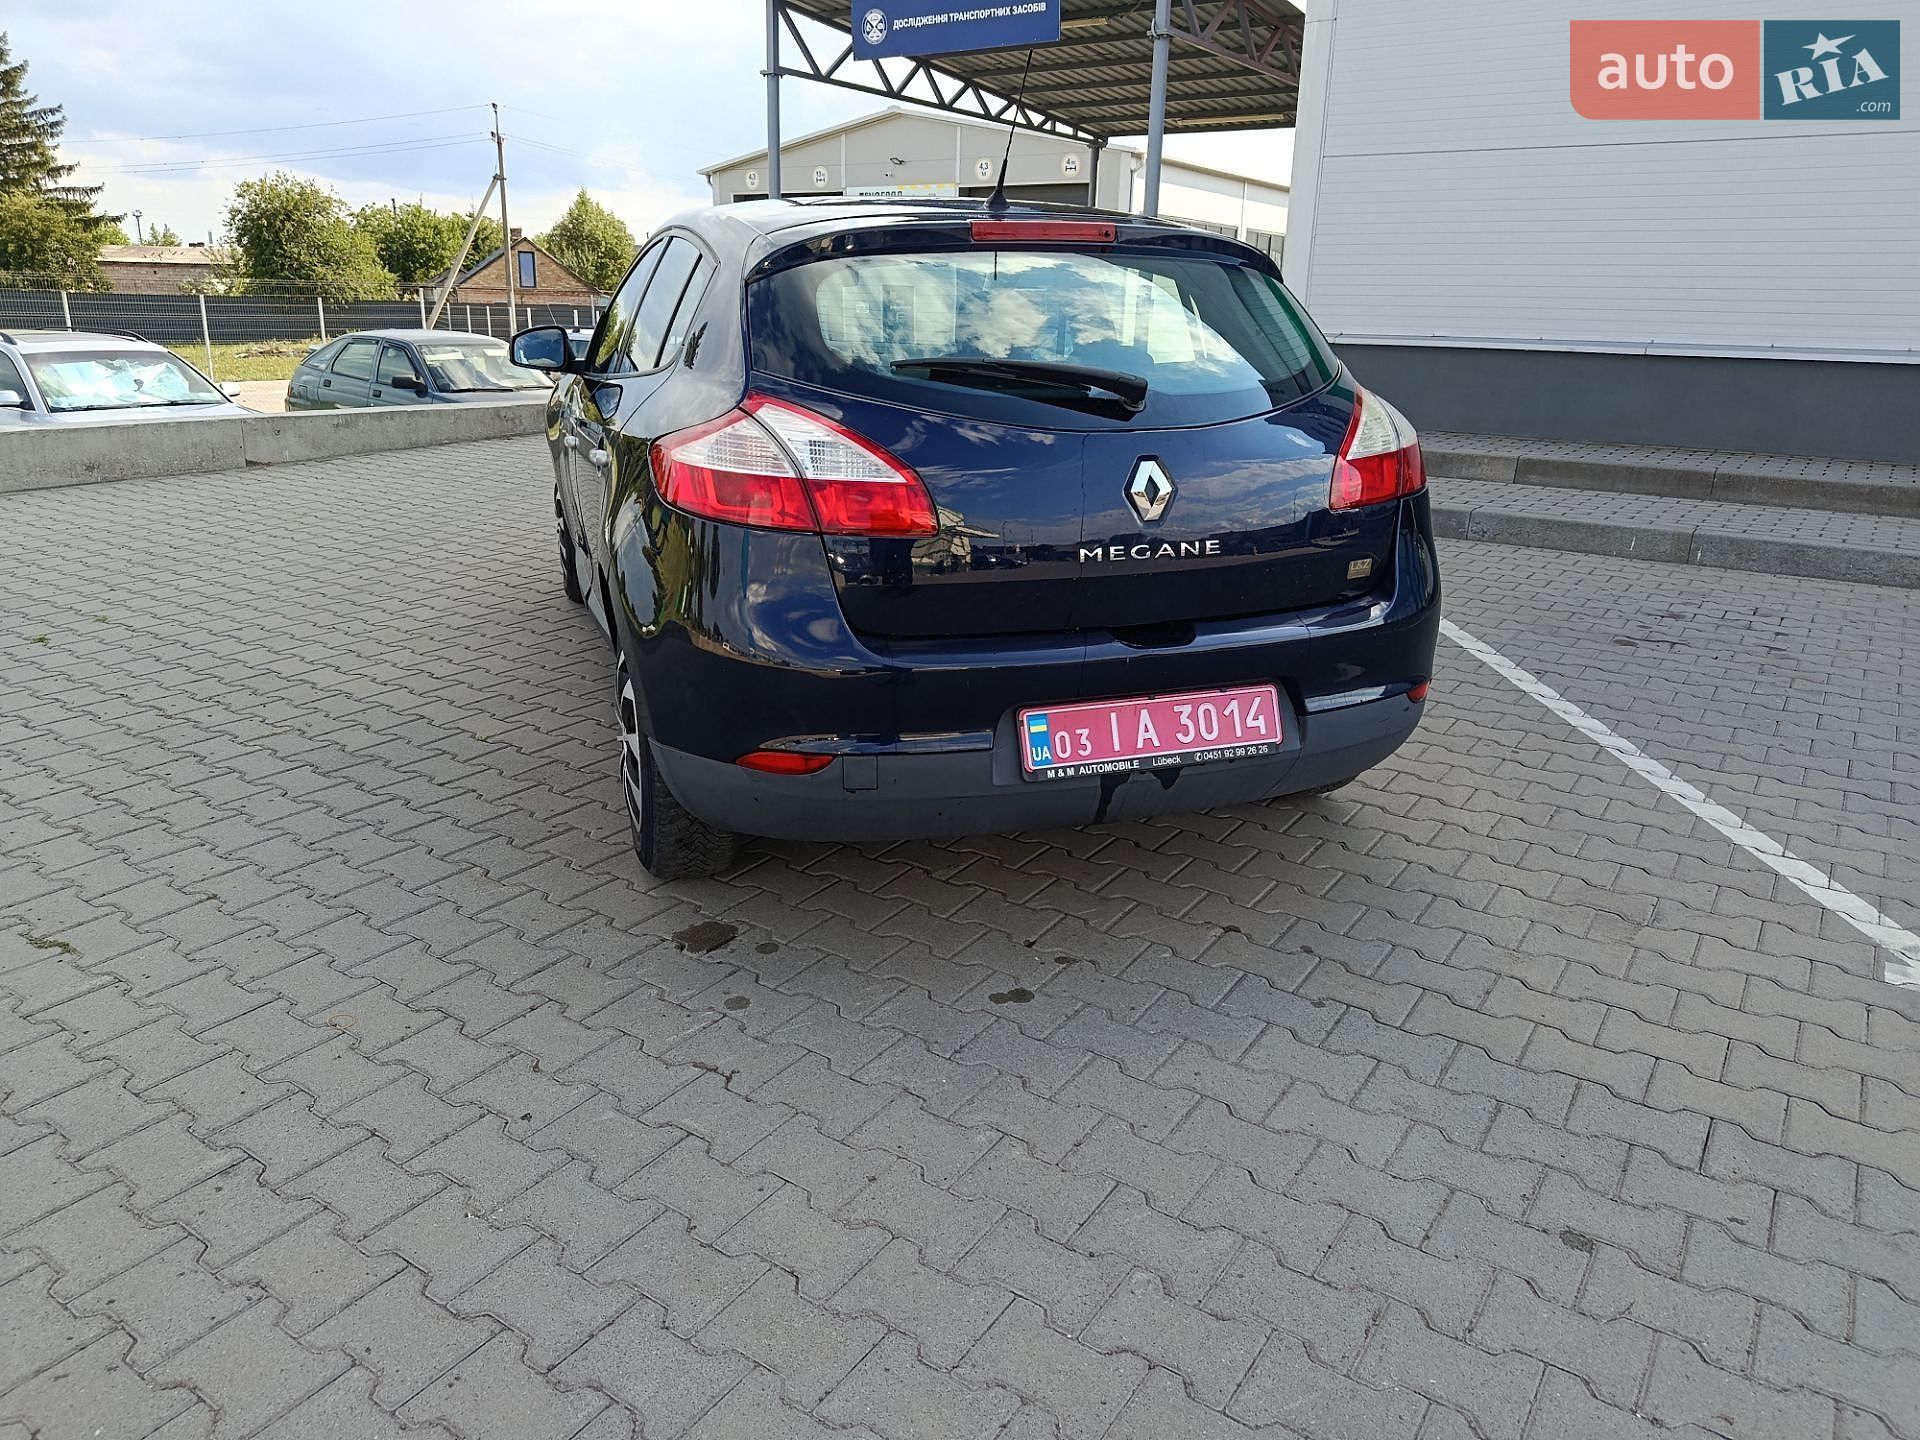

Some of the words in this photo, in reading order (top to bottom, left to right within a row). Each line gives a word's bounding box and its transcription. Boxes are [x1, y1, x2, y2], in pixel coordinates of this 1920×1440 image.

[893, 13, 948, 30] ДОСЛІДЖЕННЯ
[949, 7, 1011, 23] ТРАНСПОРТНИХ
[1012, 2, 1047, 15] ЗАСОБІВ
[1079, 539, 1221, 563] MEGANE
[1054, 728, 1093, 759] 03
[1173, 696, 1267, 744] 3014
[1031, 746, 1052, 761] UA
[1047, 769, 1055, 778] M
[1057, 768, 1065, 777] &
[1066, 767, 1075, 776] M
[1079, 760, 1140, 775] AUTOMOBILE
[1152, 755, 1182, 766] Lübeck
[1224, 748, 1235, 758] 92
[1236, 747, 1246, 757] 99
[1247, 746, 1257, 755] 26
[1258, 744, 1268, 753] 26
